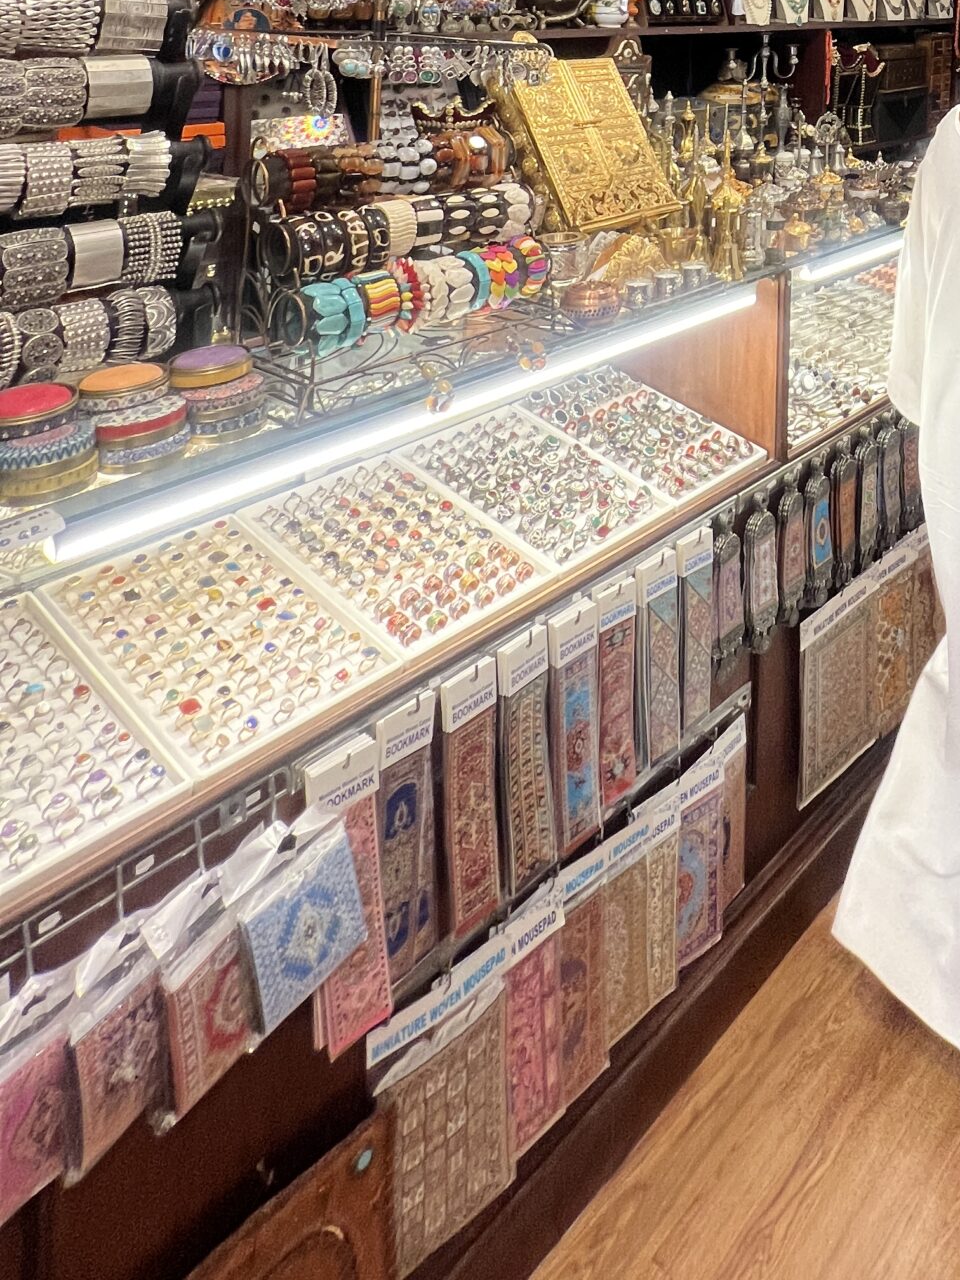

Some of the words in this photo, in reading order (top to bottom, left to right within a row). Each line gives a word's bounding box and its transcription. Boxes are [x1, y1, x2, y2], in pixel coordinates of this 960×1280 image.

[601, 604, 634, 628] BOOKMARK
[560, 631, 595, 661] BOOKMARK
[511, 656, 546, 688] BOOKMARK
[452, 688, 494, 724] BOOKMARK
[385, 724, 431, 759] BOOKMARK
[326, 774, 376, 808] OOKMARK
[689, 769, 720, 798] MOUSEPAD
[613, 824, 650, 858] MOUSEPAD
[652, 814, 676, 839] USEPAD
[565, 859, 605, 895] MOUSEPAD
[518, 910, 557, 952] MOUSEPAD
[371, 1011, 427, 1061] MINIATURE
[429, 986, 462, 1023] WOVEN
[462, 947, 506, 996] MOUSEPAD
